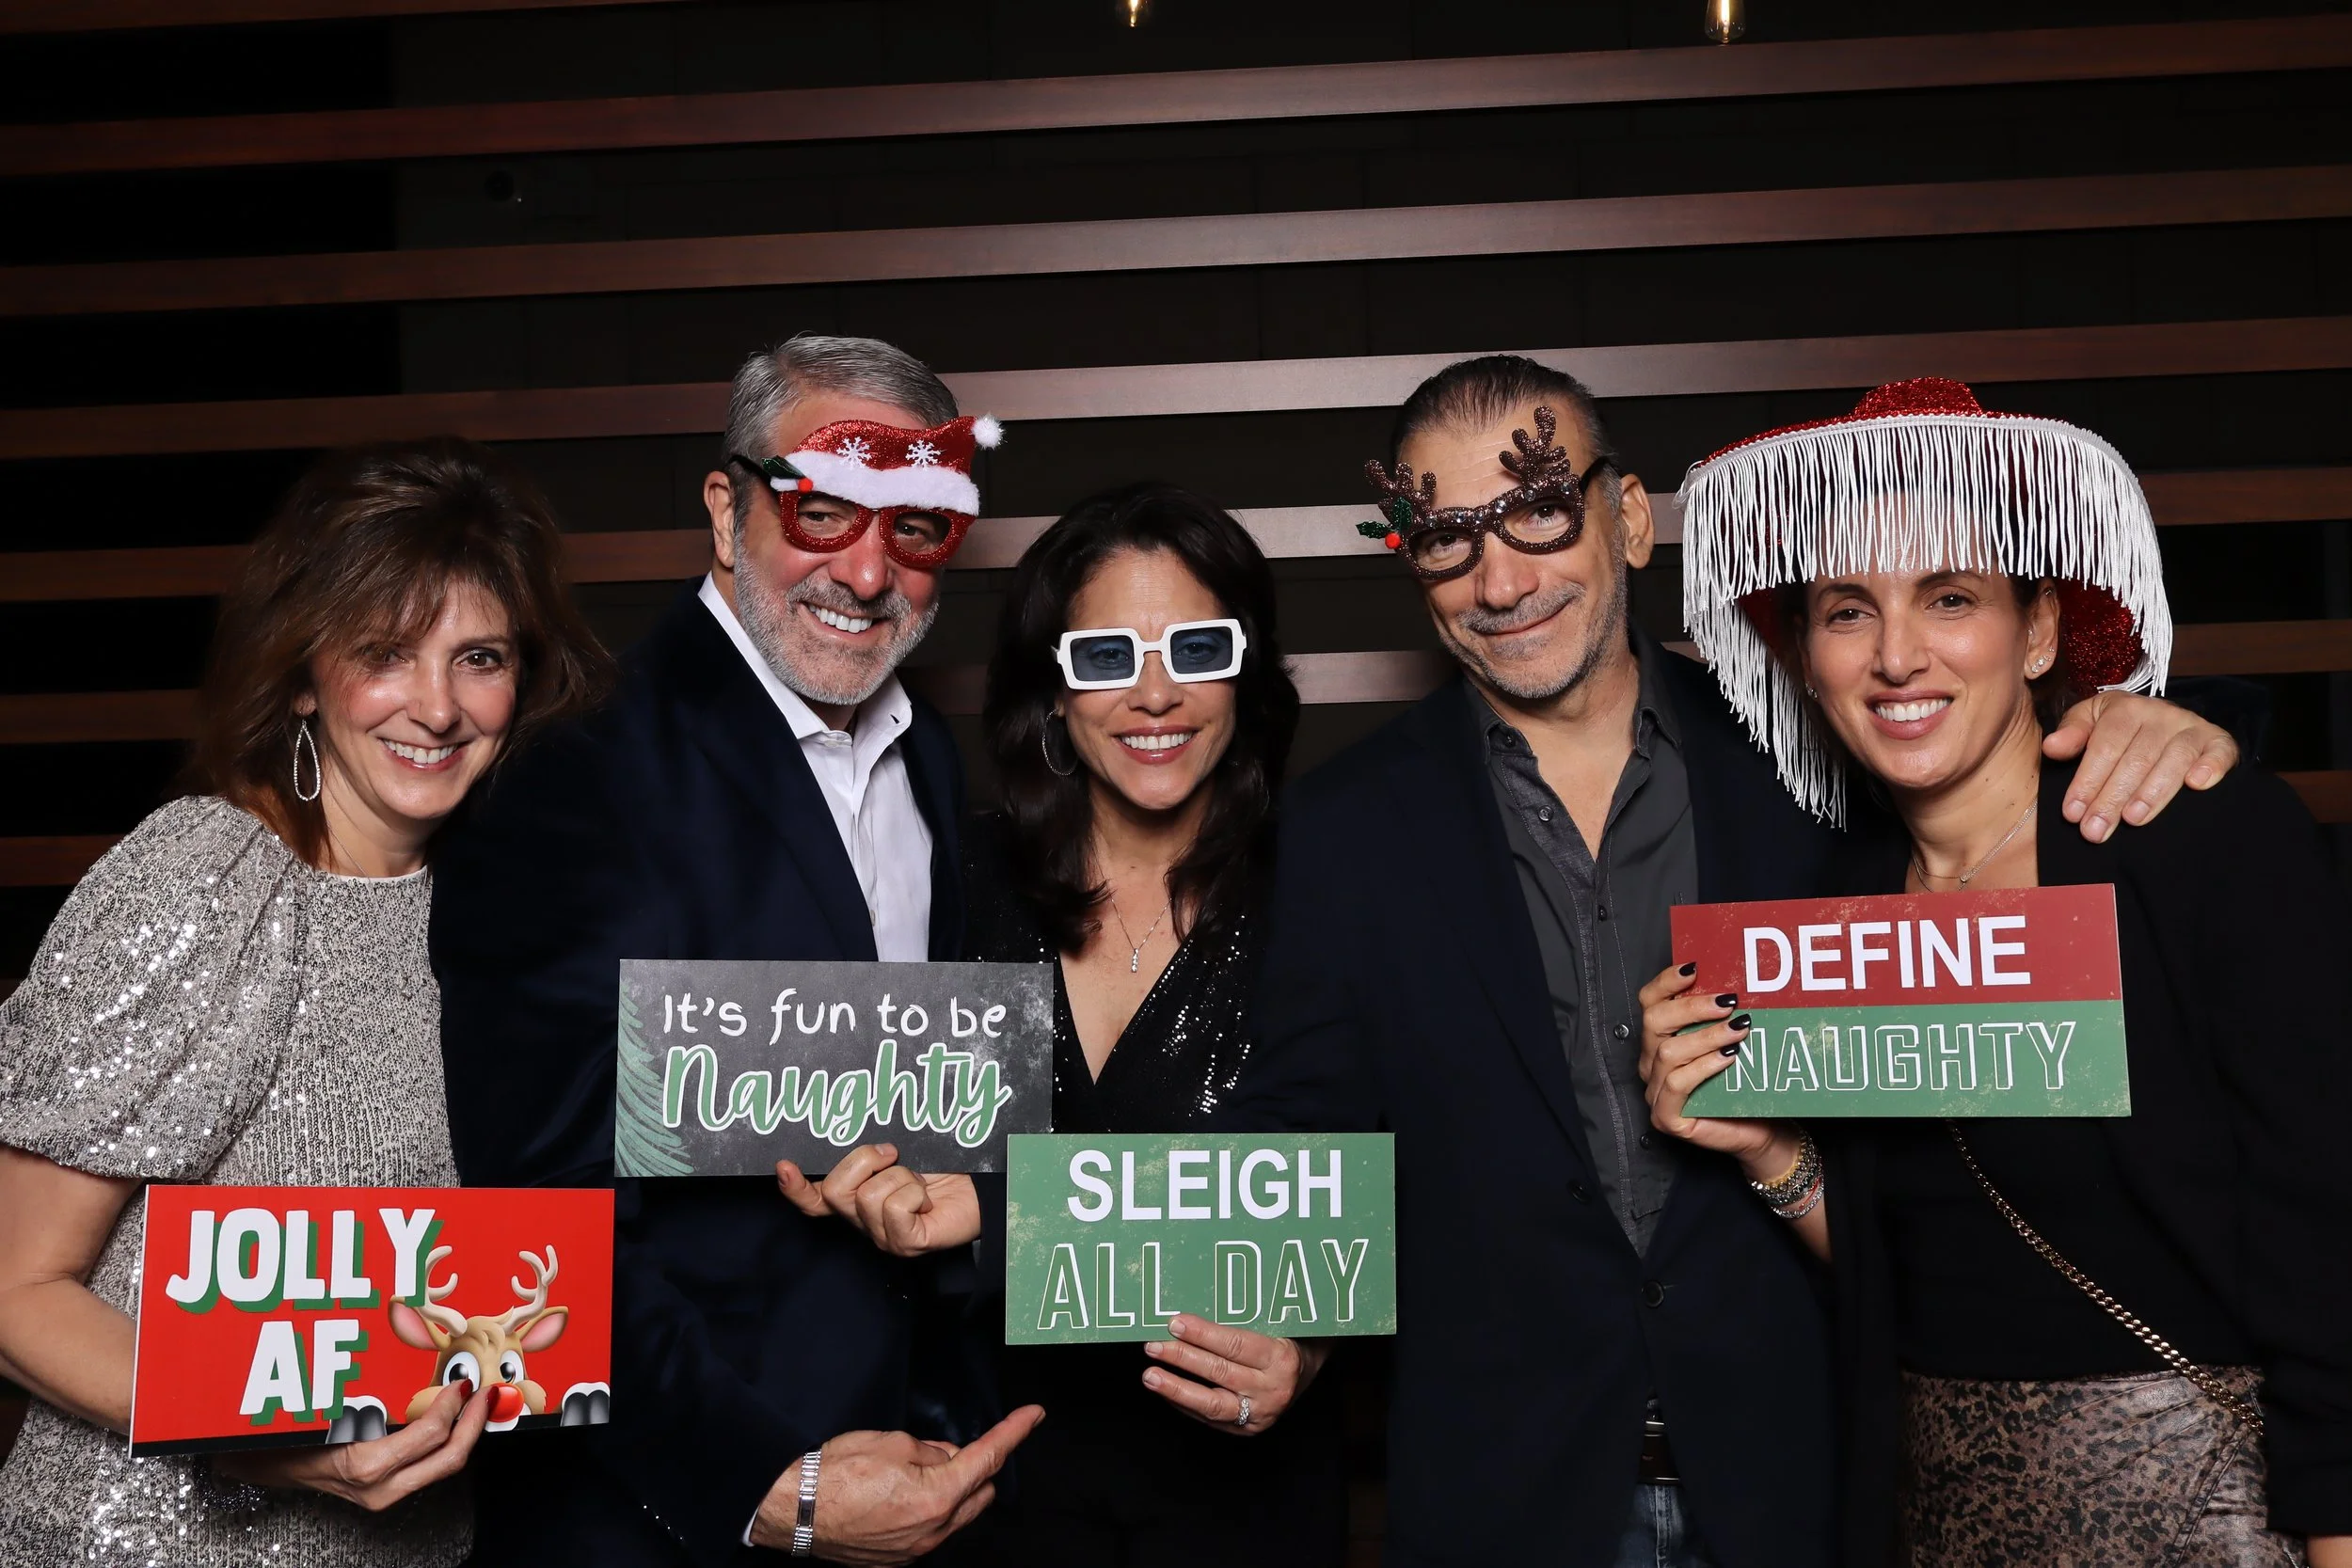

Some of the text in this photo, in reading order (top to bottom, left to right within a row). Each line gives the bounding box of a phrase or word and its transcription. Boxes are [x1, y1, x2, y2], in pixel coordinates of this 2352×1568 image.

[1743, 915, 2031, 993] DEFINE
[663, 989, 1007, 1046] It's fun to be
[1724, 1022, 2077, 1092] NAUGHTY
[661, 1038, 1012, 1148] Naughty
[1067, 1148, 1342, 1222] SLEIGH
[165, 1208, 442, 1311] JOLLY
[1037, 1239, 1369, 1330] ALL DAY
[239, 1319, 363, 1418] AF
